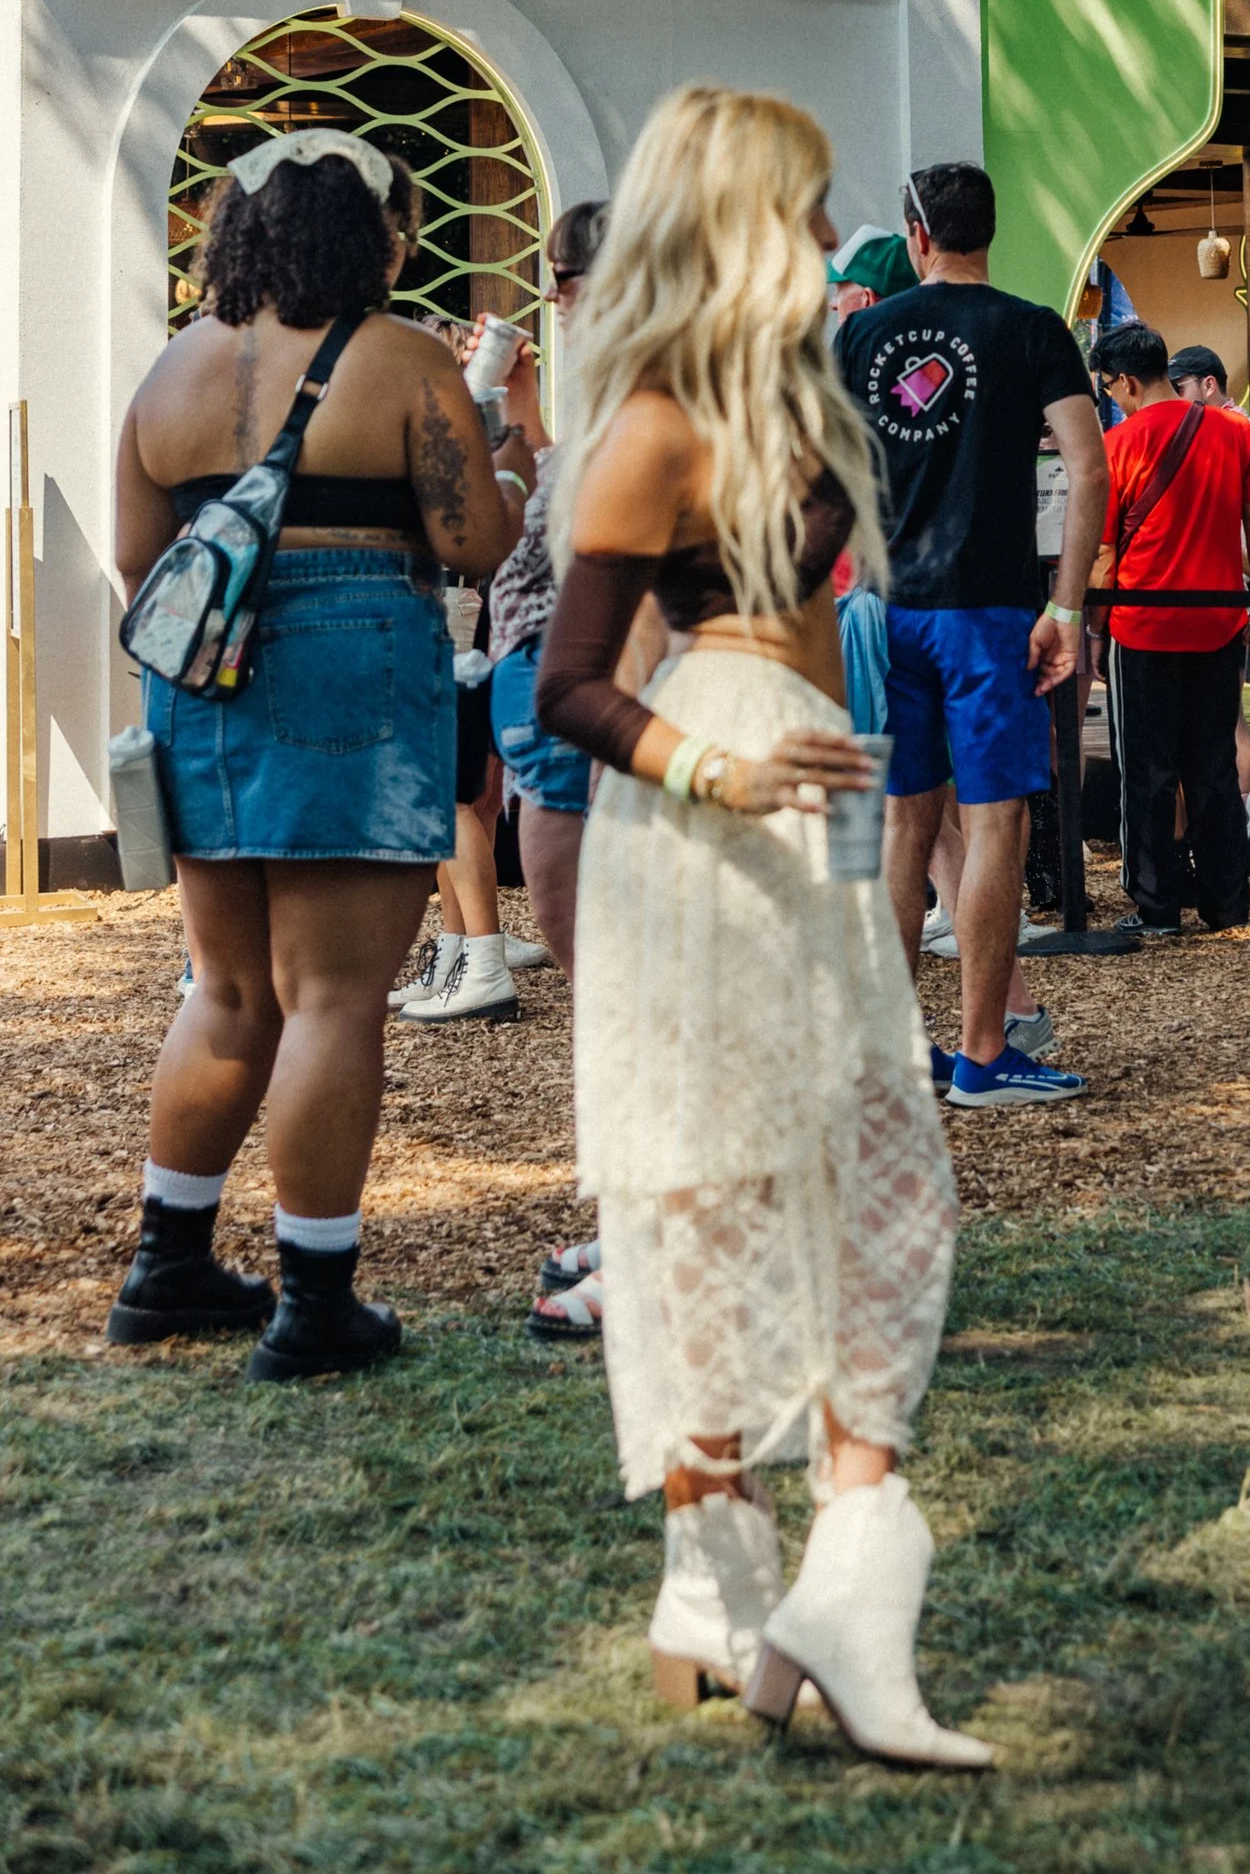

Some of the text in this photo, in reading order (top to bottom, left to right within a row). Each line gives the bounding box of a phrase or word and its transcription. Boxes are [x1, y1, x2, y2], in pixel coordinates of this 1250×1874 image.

[868, 329, 977, 404] ROCKETCUP COFFEE
[878, 412, 960, 442] COMPANY
